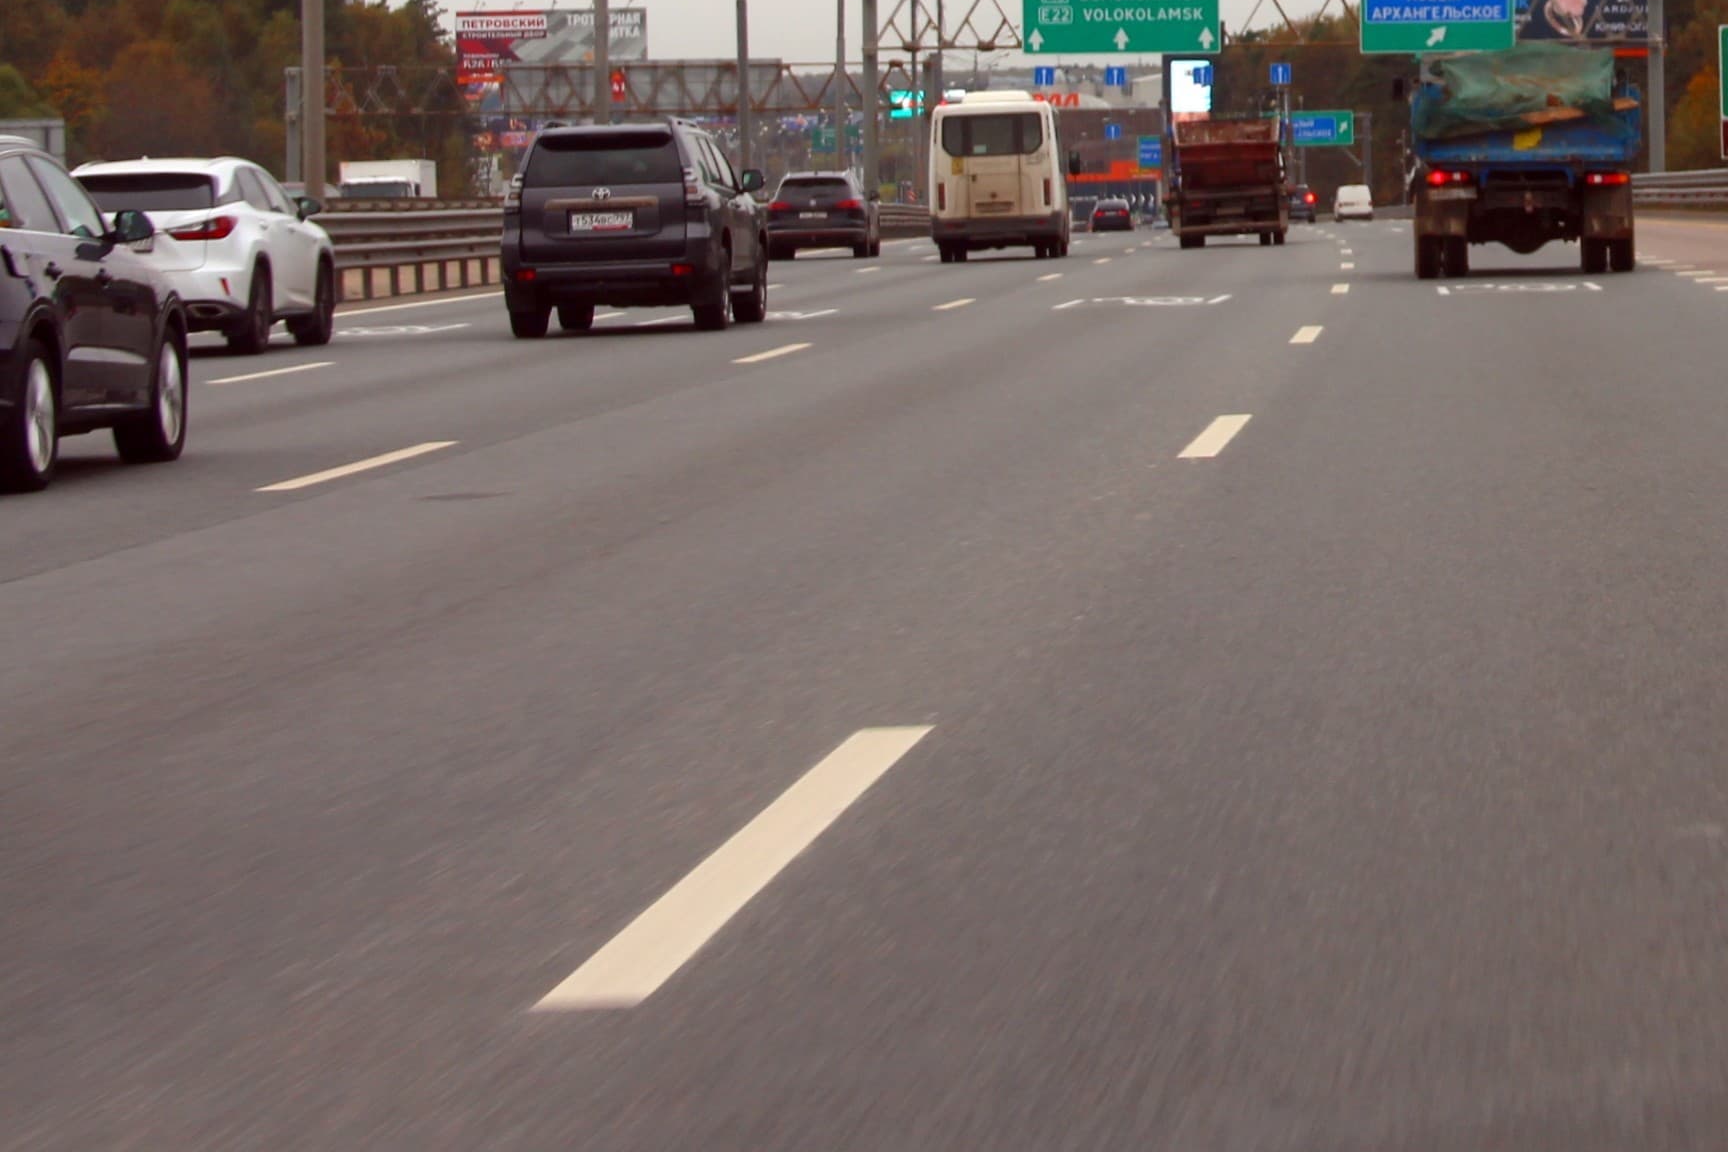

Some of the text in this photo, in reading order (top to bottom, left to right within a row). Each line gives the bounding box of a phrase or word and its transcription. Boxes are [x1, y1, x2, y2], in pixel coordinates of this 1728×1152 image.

[1040, 7, 1204, 22] E22 VOLOKOLAMSK
[1372, 5, 1502, 20] АРХАНГЕЛЬСКОЕ
[462, 17, 545, 29] ПЕТРОВСКИЙ
[567, 13, 641, 26] ТРОТРНАЯ
[462, 31, 522, 40] СТРОИТЕЛЬНЫЙ
